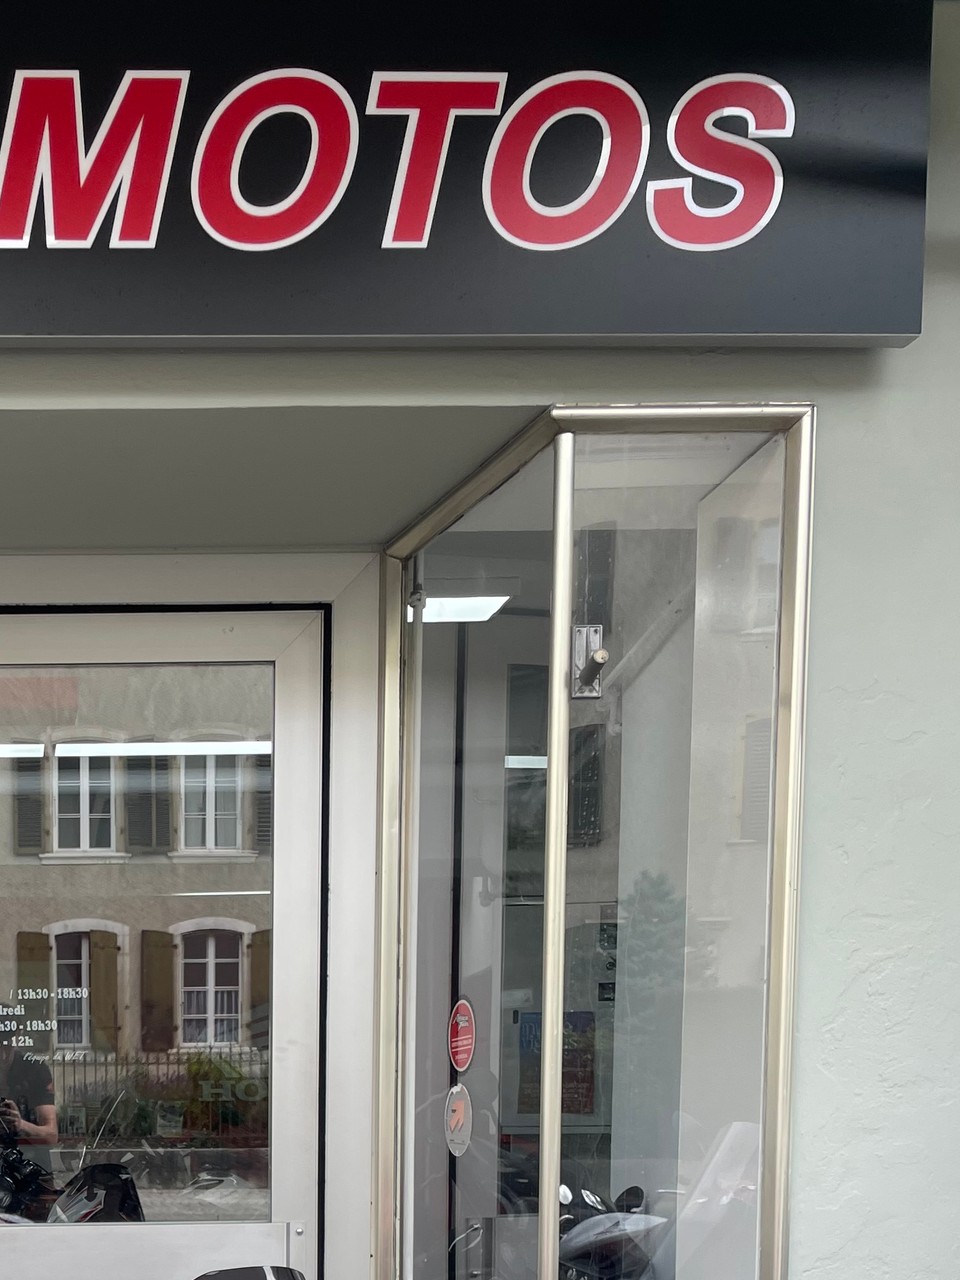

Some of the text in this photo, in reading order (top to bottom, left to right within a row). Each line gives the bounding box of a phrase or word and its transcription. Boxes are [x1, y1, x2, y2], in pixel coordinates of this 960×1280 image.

[17, 989, 48, 999] 13h30
[57, 988, 88, 999] 18h30
[26, 1020, 58, 1031] 18h30
[11, 1036, 34, 1047] 12h
